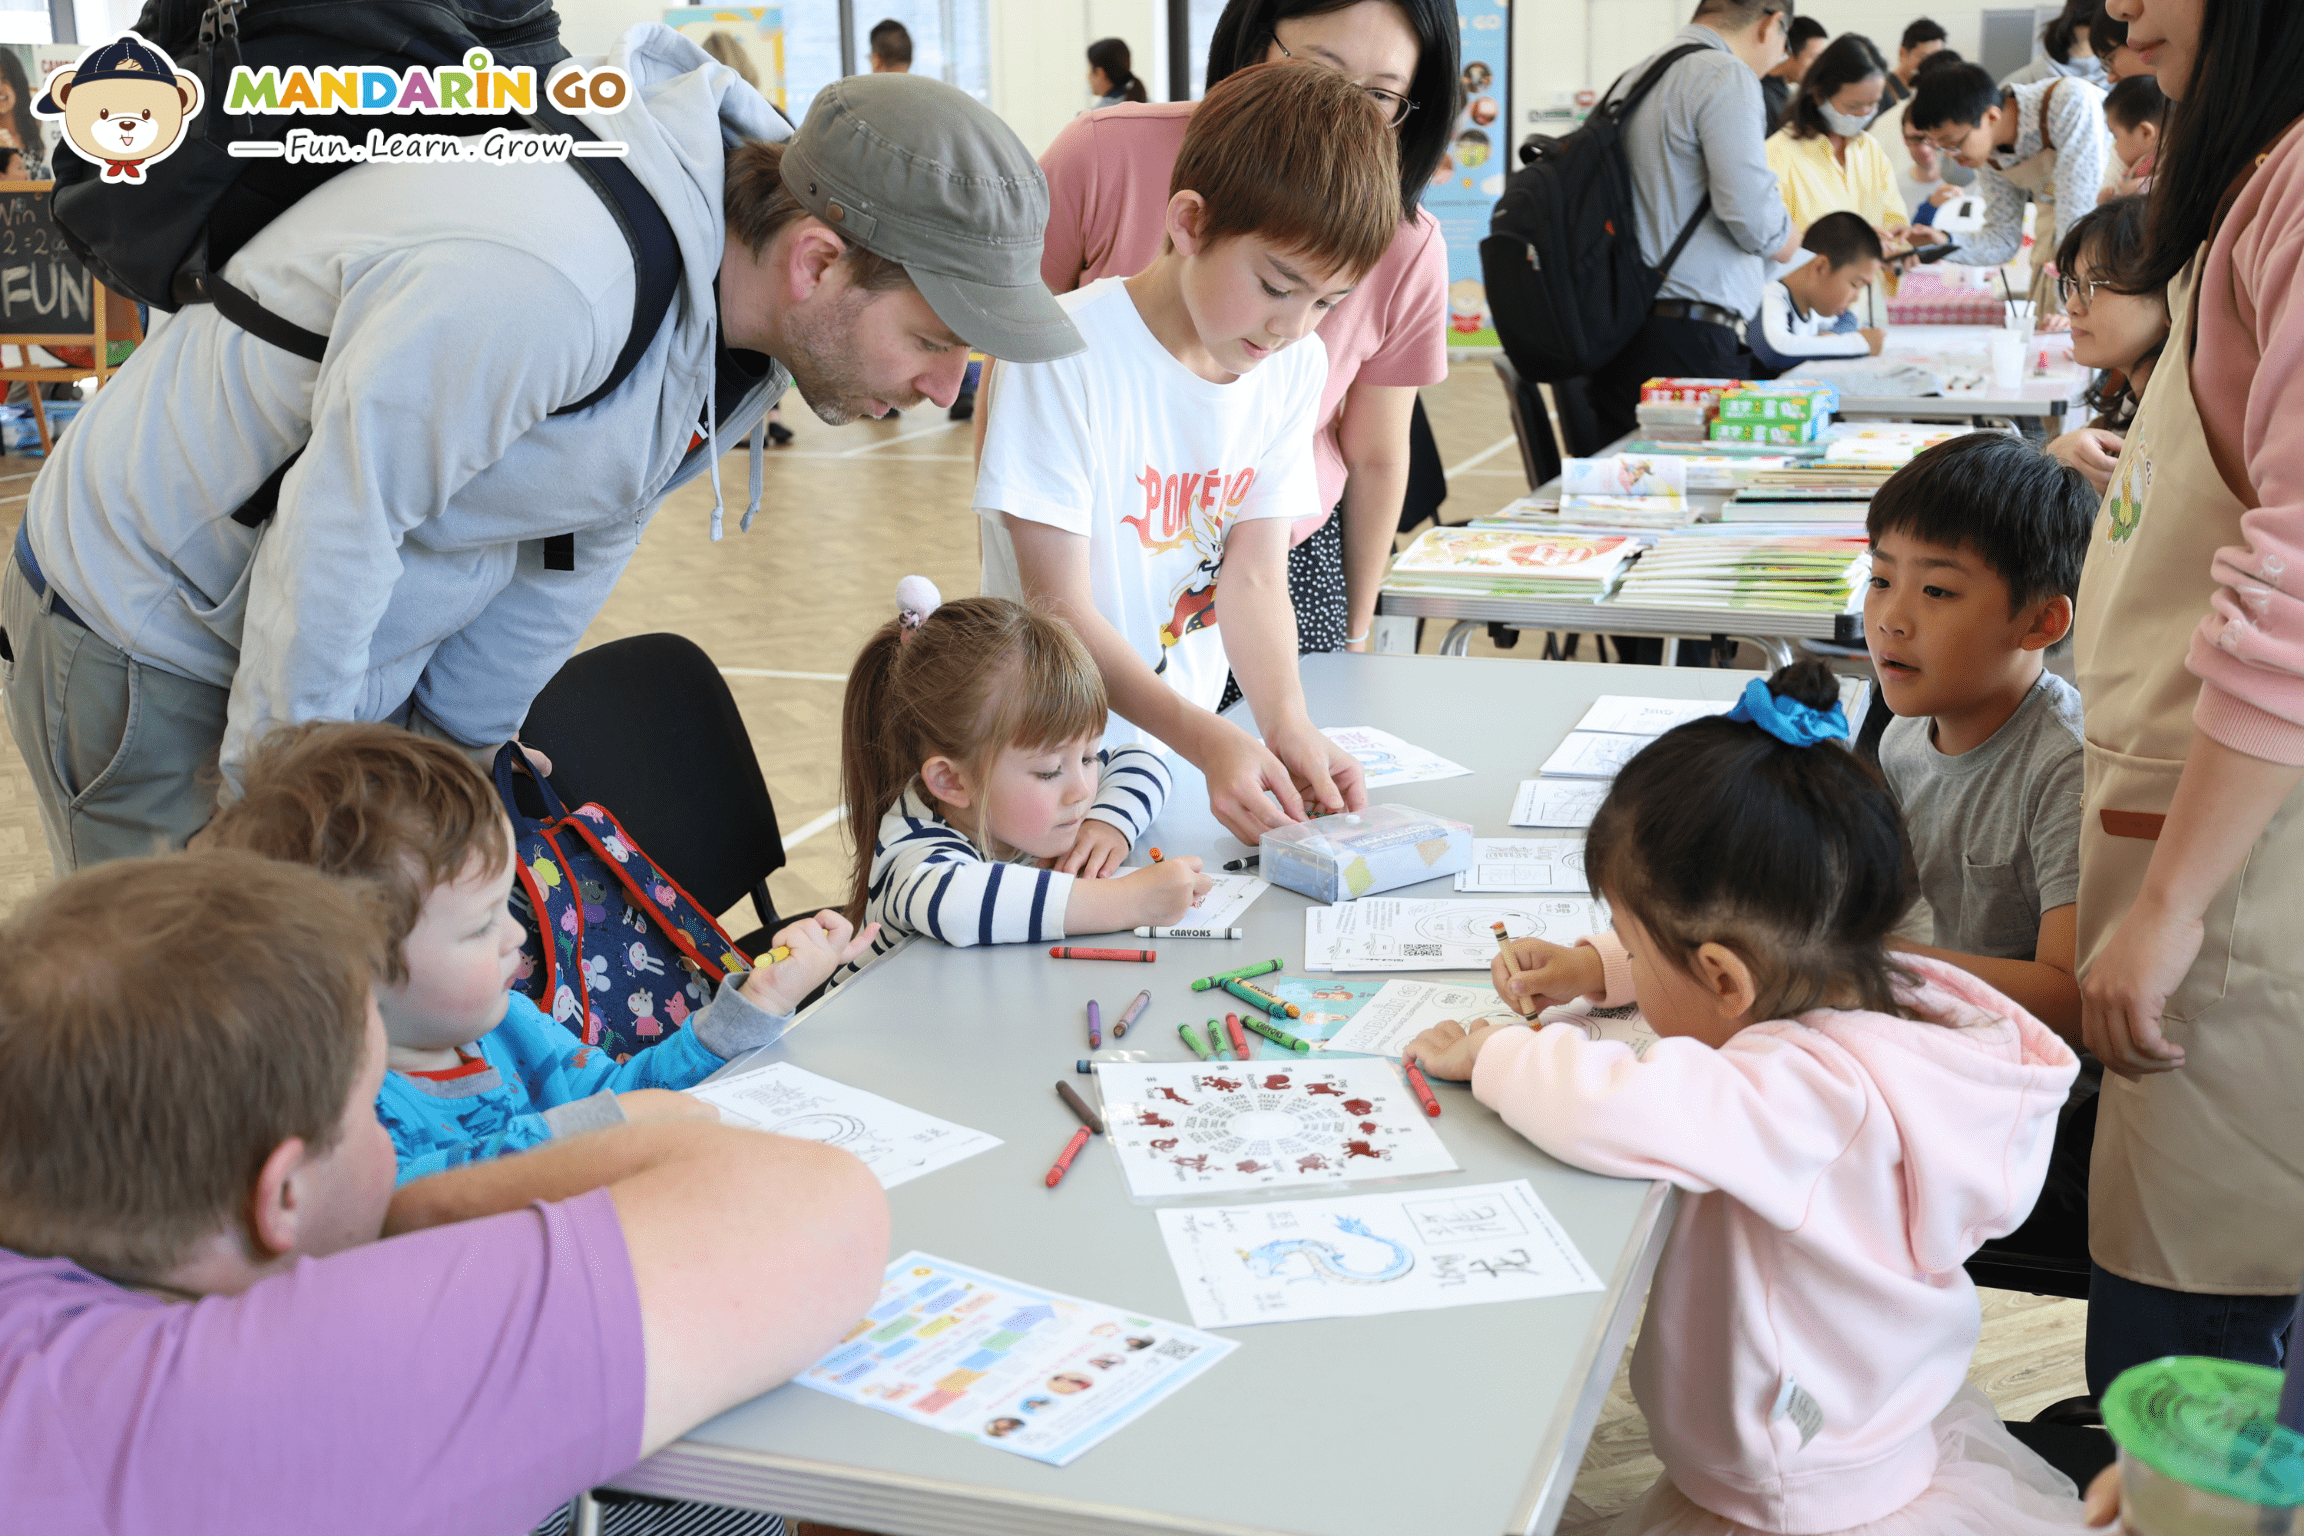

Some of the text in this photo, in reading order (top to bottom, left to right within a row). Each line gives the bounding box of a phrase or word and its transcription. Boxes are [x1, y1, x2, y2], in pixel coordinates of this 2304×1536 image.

[2, 261, 91, 321] FUN
[1169, 928, 1211, 938] CRAYONS
[1257, 1021, 1285, 1039] CRAYONS
